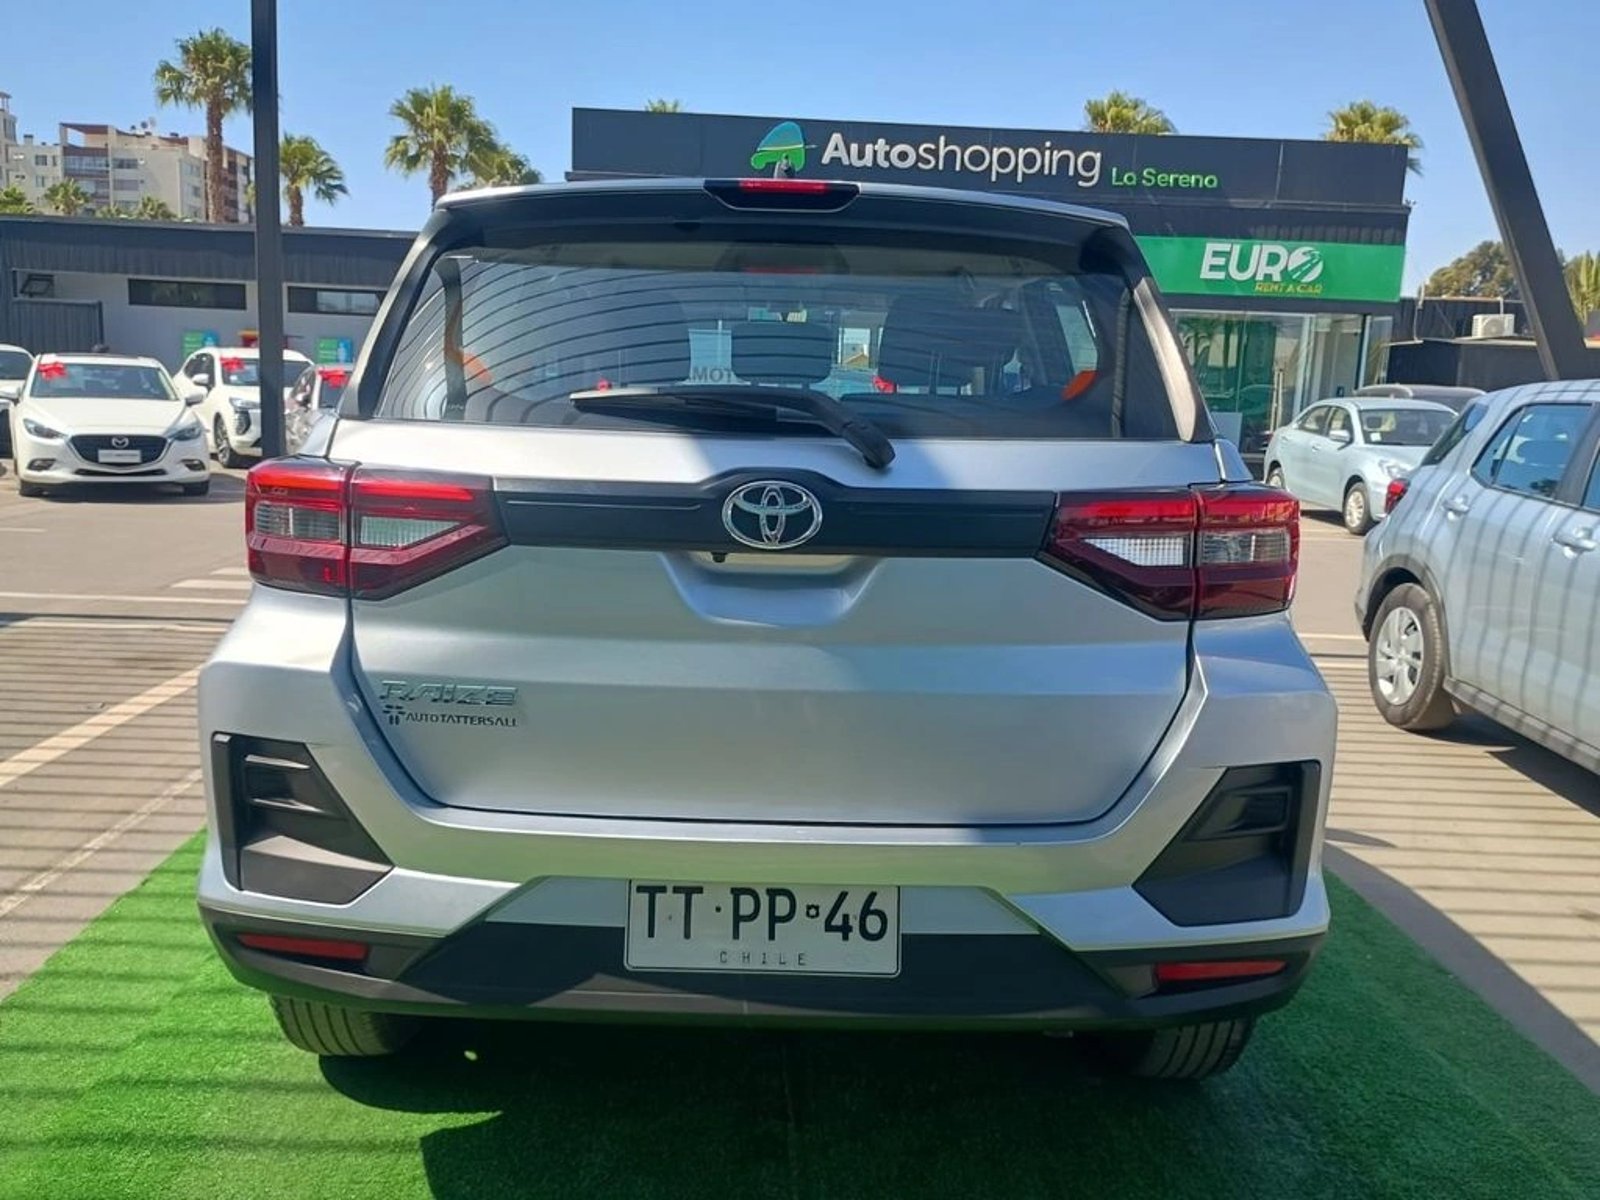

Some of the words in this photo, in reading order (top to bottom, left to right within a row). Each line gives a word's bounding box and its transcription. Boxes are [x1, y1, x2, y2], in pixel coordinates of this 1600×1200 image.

[821, 132, 1101, 187] Autoshopping
[1111, 167, 1137, 186] La
[1142, 168, 1218, 188] Serena
[1200, 243, 1324, 283] EURO
[1255, 282, 1283, 293] RENT
[379, 680, 518, 706] RAIZE
[405, 712, 517, 727] AUTOTATTERSALL
[719, 951, 807, 966] CHILE
